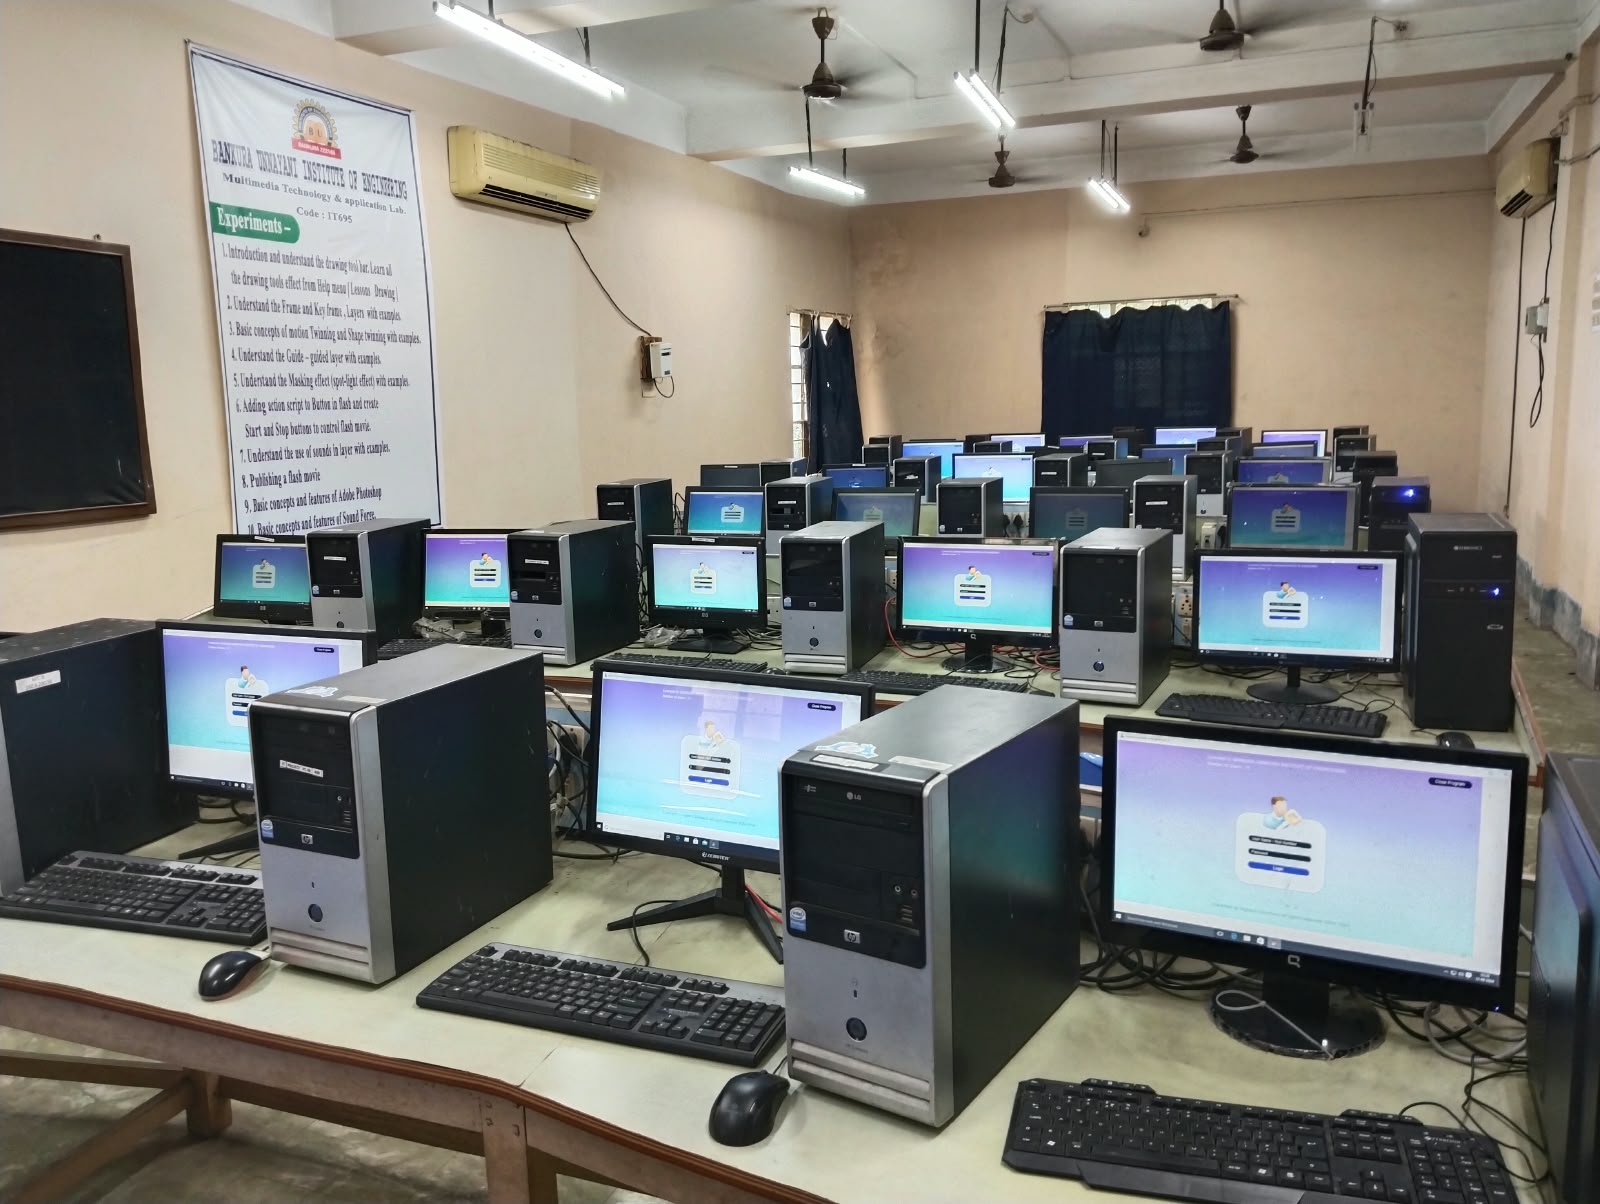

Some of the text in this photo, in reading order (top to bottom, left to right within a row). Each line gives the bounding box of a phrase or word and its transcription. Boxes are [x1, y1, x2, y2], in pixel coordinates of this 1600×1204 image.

[211, 139, 408, 200] BANKURA UNNAYANI INSTITUTE OF ENGINEERING
[222, 172, 407, 215] Multimedia Technology & application Lab.
[216, 206, 283, 234] Experiments
[296, 206, 320, 218] Code
[327, 211, 353, 224] IT695
[221, 242, 227, 257] 1.
[227, 243, 268, 263] Introduction
[269, 249, 281, 264] and
[281, 251, 315, 268] understand
[315, 254, 324, 269] the
[325, 255, 348, 275] drawing
[348, 259, 358, 273] tool
[369, 260, 385, 275] Learn
[230, 269, 241, 285] the
[242, 270, 269, 291] drawing
[269, 274, 284, 289] tools
[285, 275, 301, 290] effect
[302, 276, 316, 292] from
[316, 278, 331, 297] Help
[331, 283, 346, 294] menu
[226, 294, 233, 310] 2.
[233, 295, 270, 312] Understand
[270, 298, 281, 313] the
[281, 299, 301, 315] Frame
[302, 301, 313, 315] and
[313, 301, 325, 320] Key
[326, 302, 342, 317] frame
[346, 304, 365, 322] Layers
[366, 306, 378, 320] with
[229, 320, 421, 347] 3. Basic concepts of motion Twinning and Shape twinning with examples.
[231, 347, 237, 361] 4.
[238, 347, 274, 362] Understand
[275, 348, 285, 362] the
[286, 348, 304, 363] Guide
[309, 349, 329, 367] guided
[329, 349, 343, 367] layer
[344, 350, 357, 364] with
[233, 372, 239, 388] 5.
[240, 372, 277, 388] Understand
[277, 372, 287, 388] the
[288, 372, 314, 390] Masking
[314, 373, 330, 387] effect
[375, 374, 387, 387] with
[235, 396, 379, 416] 6. Adding action script to Button in flash and create
[245, 418, 372, 440] Start and Stop buttons to control flash movie.
[239, 440, 391, 464] 7. Understand the use of sounds in layer with examples.
[241, 467, 321, 489] 8. Publishing a flash movie
[244, 485, 382, 514] 9. Basic concepts and features of Adobe Photoshop
[256, 521, 274, 536] Basic
[275, 519, 301, 536] concepts
[301, 515, 313, 530] and
[313, 514, 335, 528] features
[336, 511, 342, 525] of
[342, 509, 360, 524] Sound
